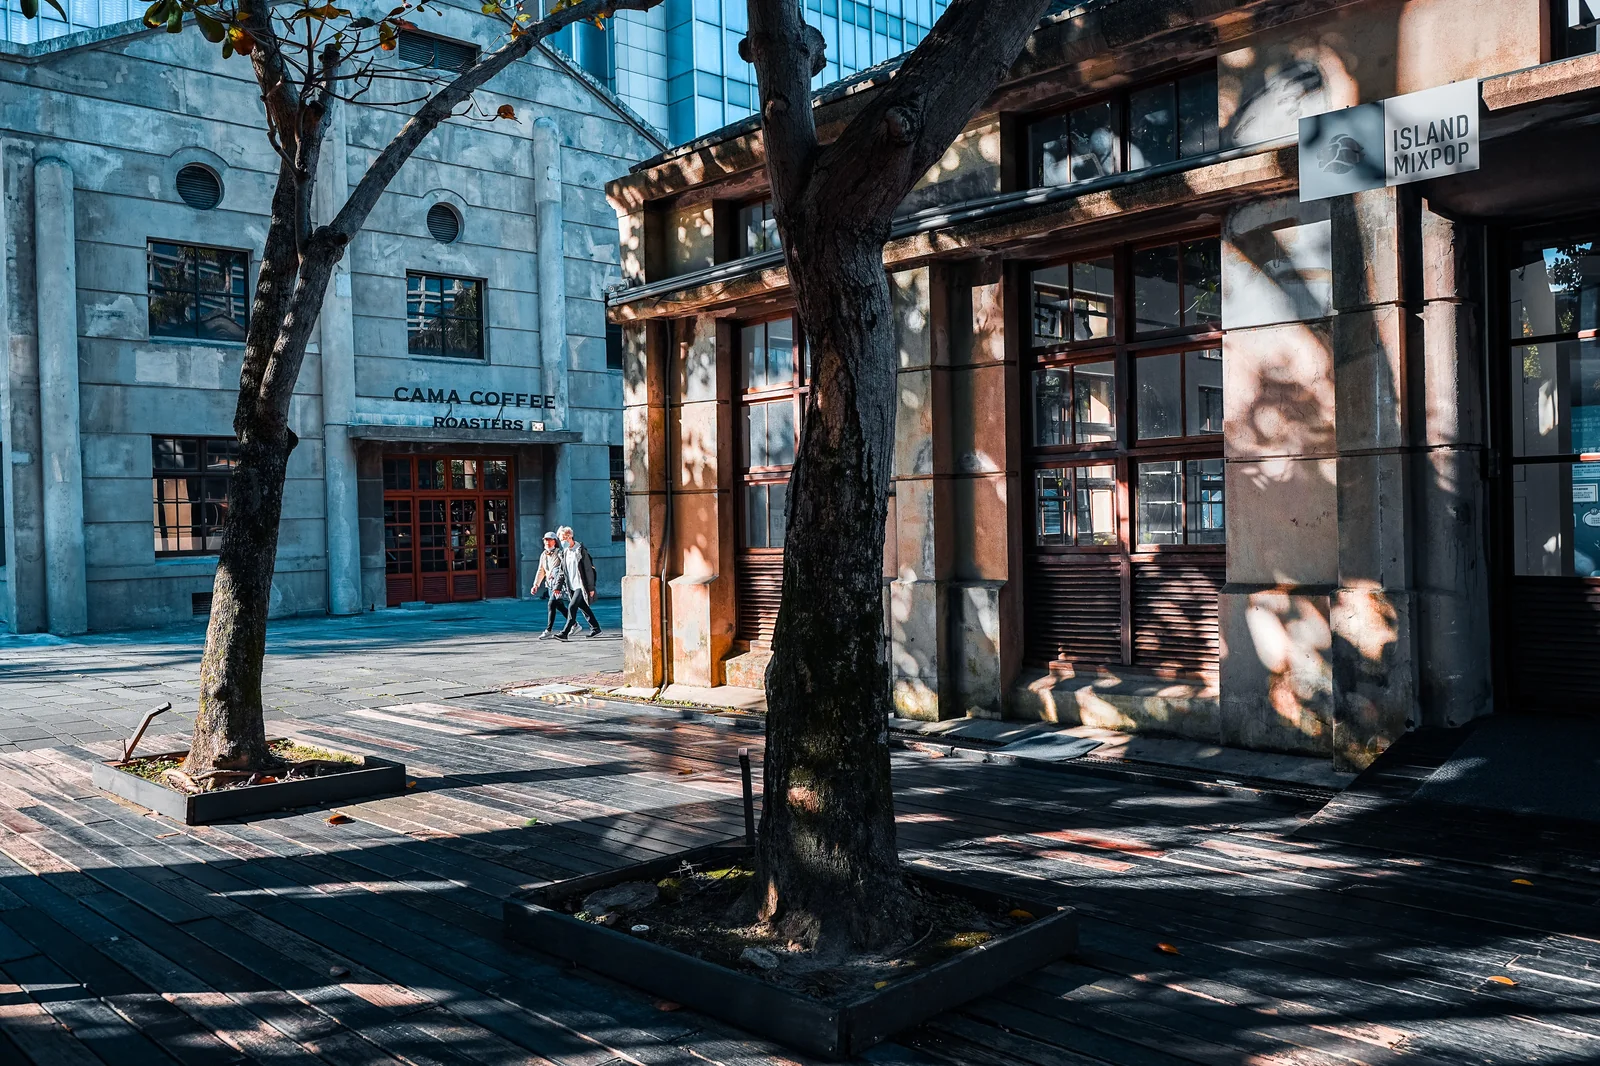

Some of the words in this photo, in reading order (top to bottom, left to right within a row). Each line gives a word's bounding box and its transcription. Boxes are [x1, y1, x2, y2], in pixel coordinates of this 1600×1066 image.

[1393, 114, 1469, 152] ISLAND
[1394, 142, 1470, 177] MIXPOP
[394, 387, 461, 404] CAMA
[469, 391, 556, 409] COFFEE
[433, 416, 524, 431] ROASTERS
